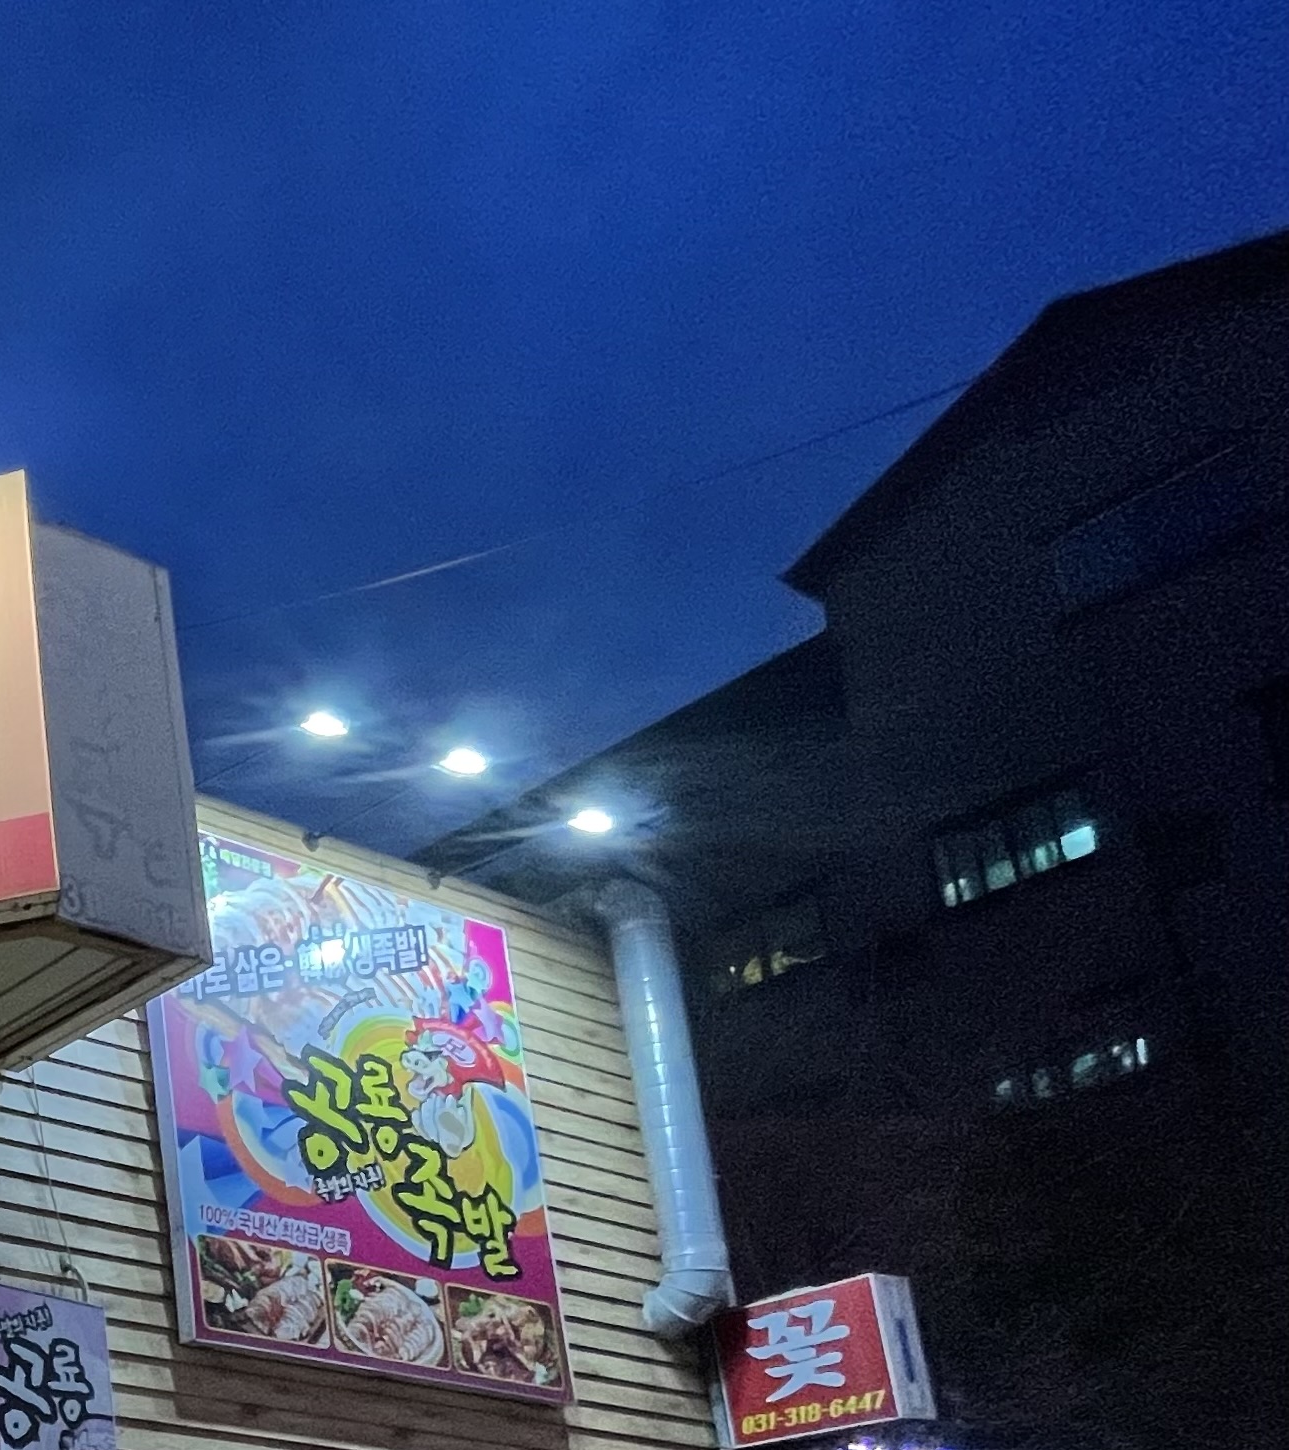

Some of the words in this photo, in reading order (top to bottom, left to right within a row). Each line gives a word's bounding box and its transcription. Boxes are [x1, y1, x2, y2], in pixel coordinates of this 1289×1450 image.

[349, 927, 427, 977] 생족발!
[283, 1044, 411, 1176] 공룡
[199, 1203, 236, 1228] 100%
[238, 1211, 279, 1238] 국내산
[281, 1219, 321, 1247] 최상급
[323, 1228, 350, 1252] 생족
[392, 1142, 519, 1281] 족발
[746, 1299, 850, 1403] 꽃
[741, 1389, 886, 1436] 031-318-6447
